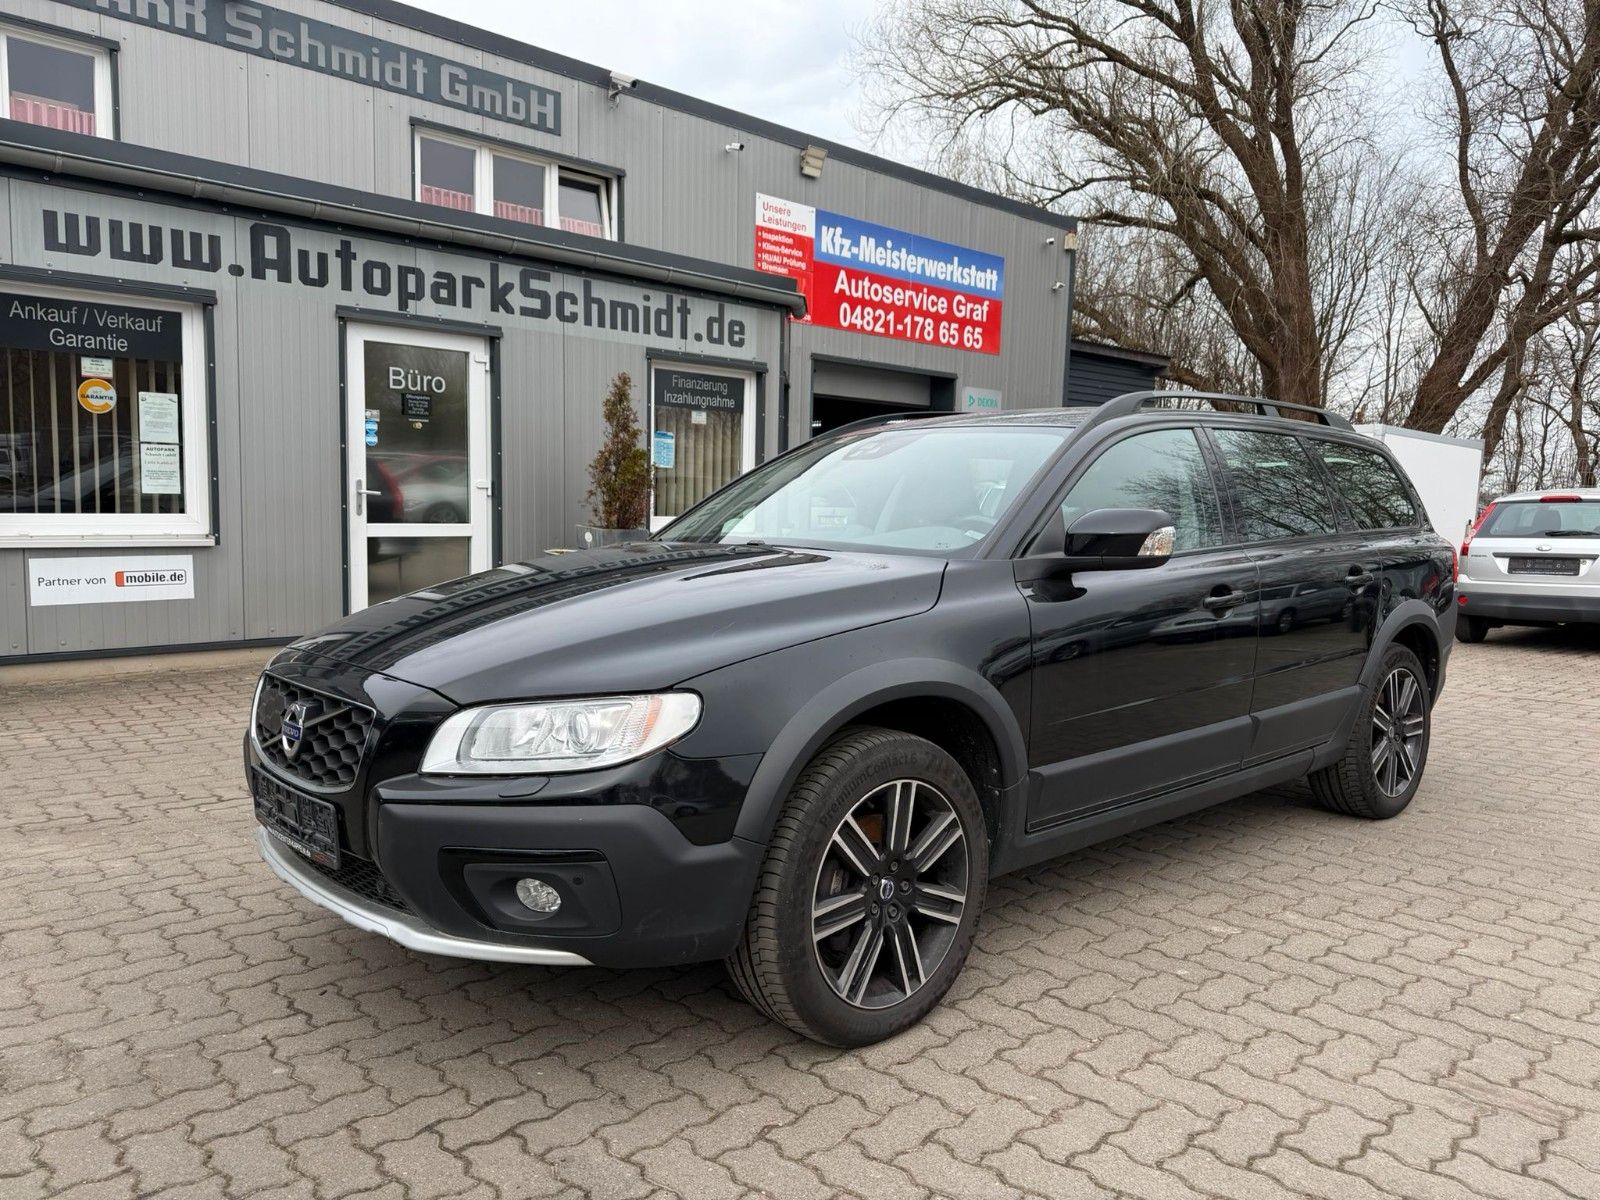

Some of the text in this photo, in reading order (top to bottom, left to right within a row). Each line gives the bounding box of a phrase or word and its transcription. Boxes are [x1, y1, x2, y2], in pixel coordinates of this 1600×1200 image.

[224, 3, 428, 95] Schmidt
[440, 63, 555, 129] GmbH
[762, 201, 791, 216] Unsere
[762, 213, 807, 232] Leistungen
[762, 231, 794, 245] Inspektion
[820, 225, 999, 292] Kfz-Meisterwerkstatt
[42, 209, 747, 348] www.AutoparkSchmidt.de
[834, 270, 989, 322] Autoservice Graf
[9, 300, 163, 333] Ankauf / Verkauf
[839, 302, 934, 342] 04821-178
[939, 323, 959, 346] 65
[963, 327, 983, 349] 65
[49, 328, 128, 351] Garantie
[388, 366, 446, 394] Büro
[672, 374, 728, 395] Finanzierung
[664, 390, 735, 408] Inzahlungnahme
[977, 396, 998, 408] DEKRA
[37, 570, 184, 587] Partner von mobile.de
